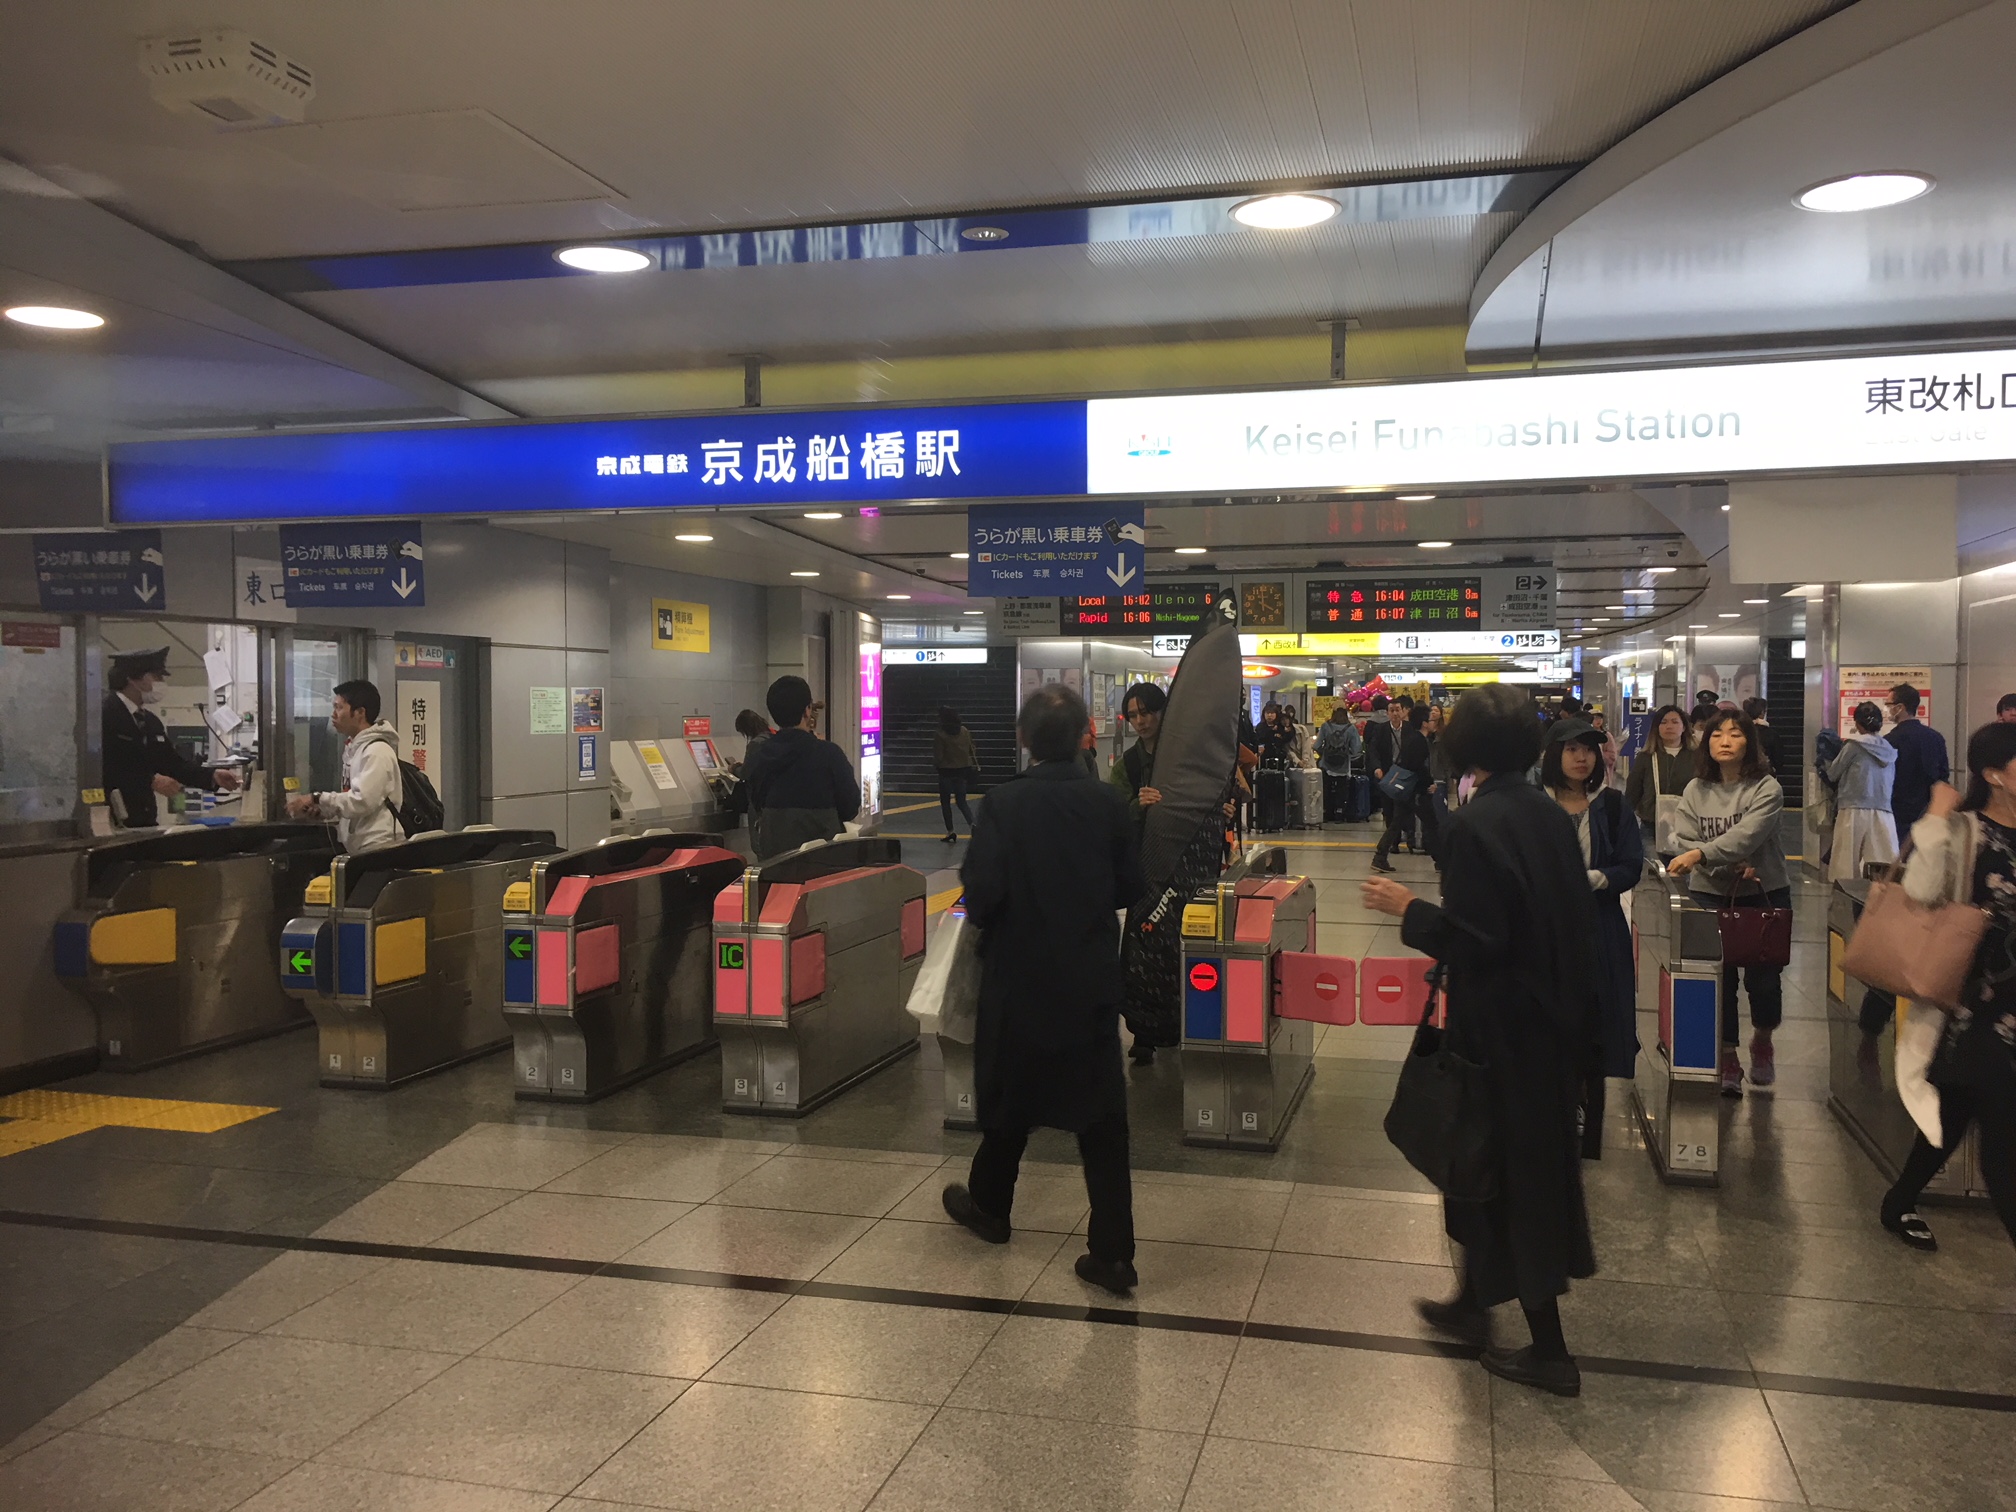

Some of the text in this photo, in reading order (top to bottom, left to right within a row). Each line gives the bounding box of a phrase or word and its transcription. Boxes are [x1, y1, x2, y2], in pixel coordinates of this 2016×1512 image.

[1246, 421, 1358, 457] Keisei
[1595, 408, 1741, 443] Station
[596, 429, 962, 486] 京成電鉄 京成船橋駅
[974, 526, 1103, 545] うらが黒い乗車券
[284, 544, 389, 561] うらが黒い乗車券
[993, 552, 1098, 561] ICカードもご利用いただけます
[991, 569, 1023, 579] Tickets
[1059, 568, 1084, 578] 승차권
[244, 571, 286, 606] 東口
[299, 582, 325, 592] Tickets
[1078, 596, 1107, 607] Local
[1123, 595, 1150, 606] 16:02
[1155, 594, 1195, 605] Ueno
[1327, 590, 1363, 603] 特急
[1375, 590, 1404, 602] 16:04
[1410, 588, 1459, 601] 成田空港
[1079, 612, 1109, 624] Rapid
[1123, 611, 1150, 623] 16:06
[1327, 608, 1363, 622] 普通
[1375, 608, 1404, 620] 16:07
[1410, 607, 1459, 620] 津田沼
[1504, 636, 1511, 646] 2
[425, 648, 443, 659] AED
[721, 945, 744, 967] IC
[365, 1057, 373, 1067] 2
[528, 1067, 536, 1077] 2
[564, 1069, 572, 1079] 3
[737, 1079, 745, 1089] 3
[775, 1082, 784, 1092] 4
[960, 1094, 969, 1104] 4
[1201, 1110, 1210, 1120] 5
[1245, 1113, 1255, 1124] 6
[1677, 1144, 1688, 1155] 7
[1696, 1145, 1707, 1157] 8
